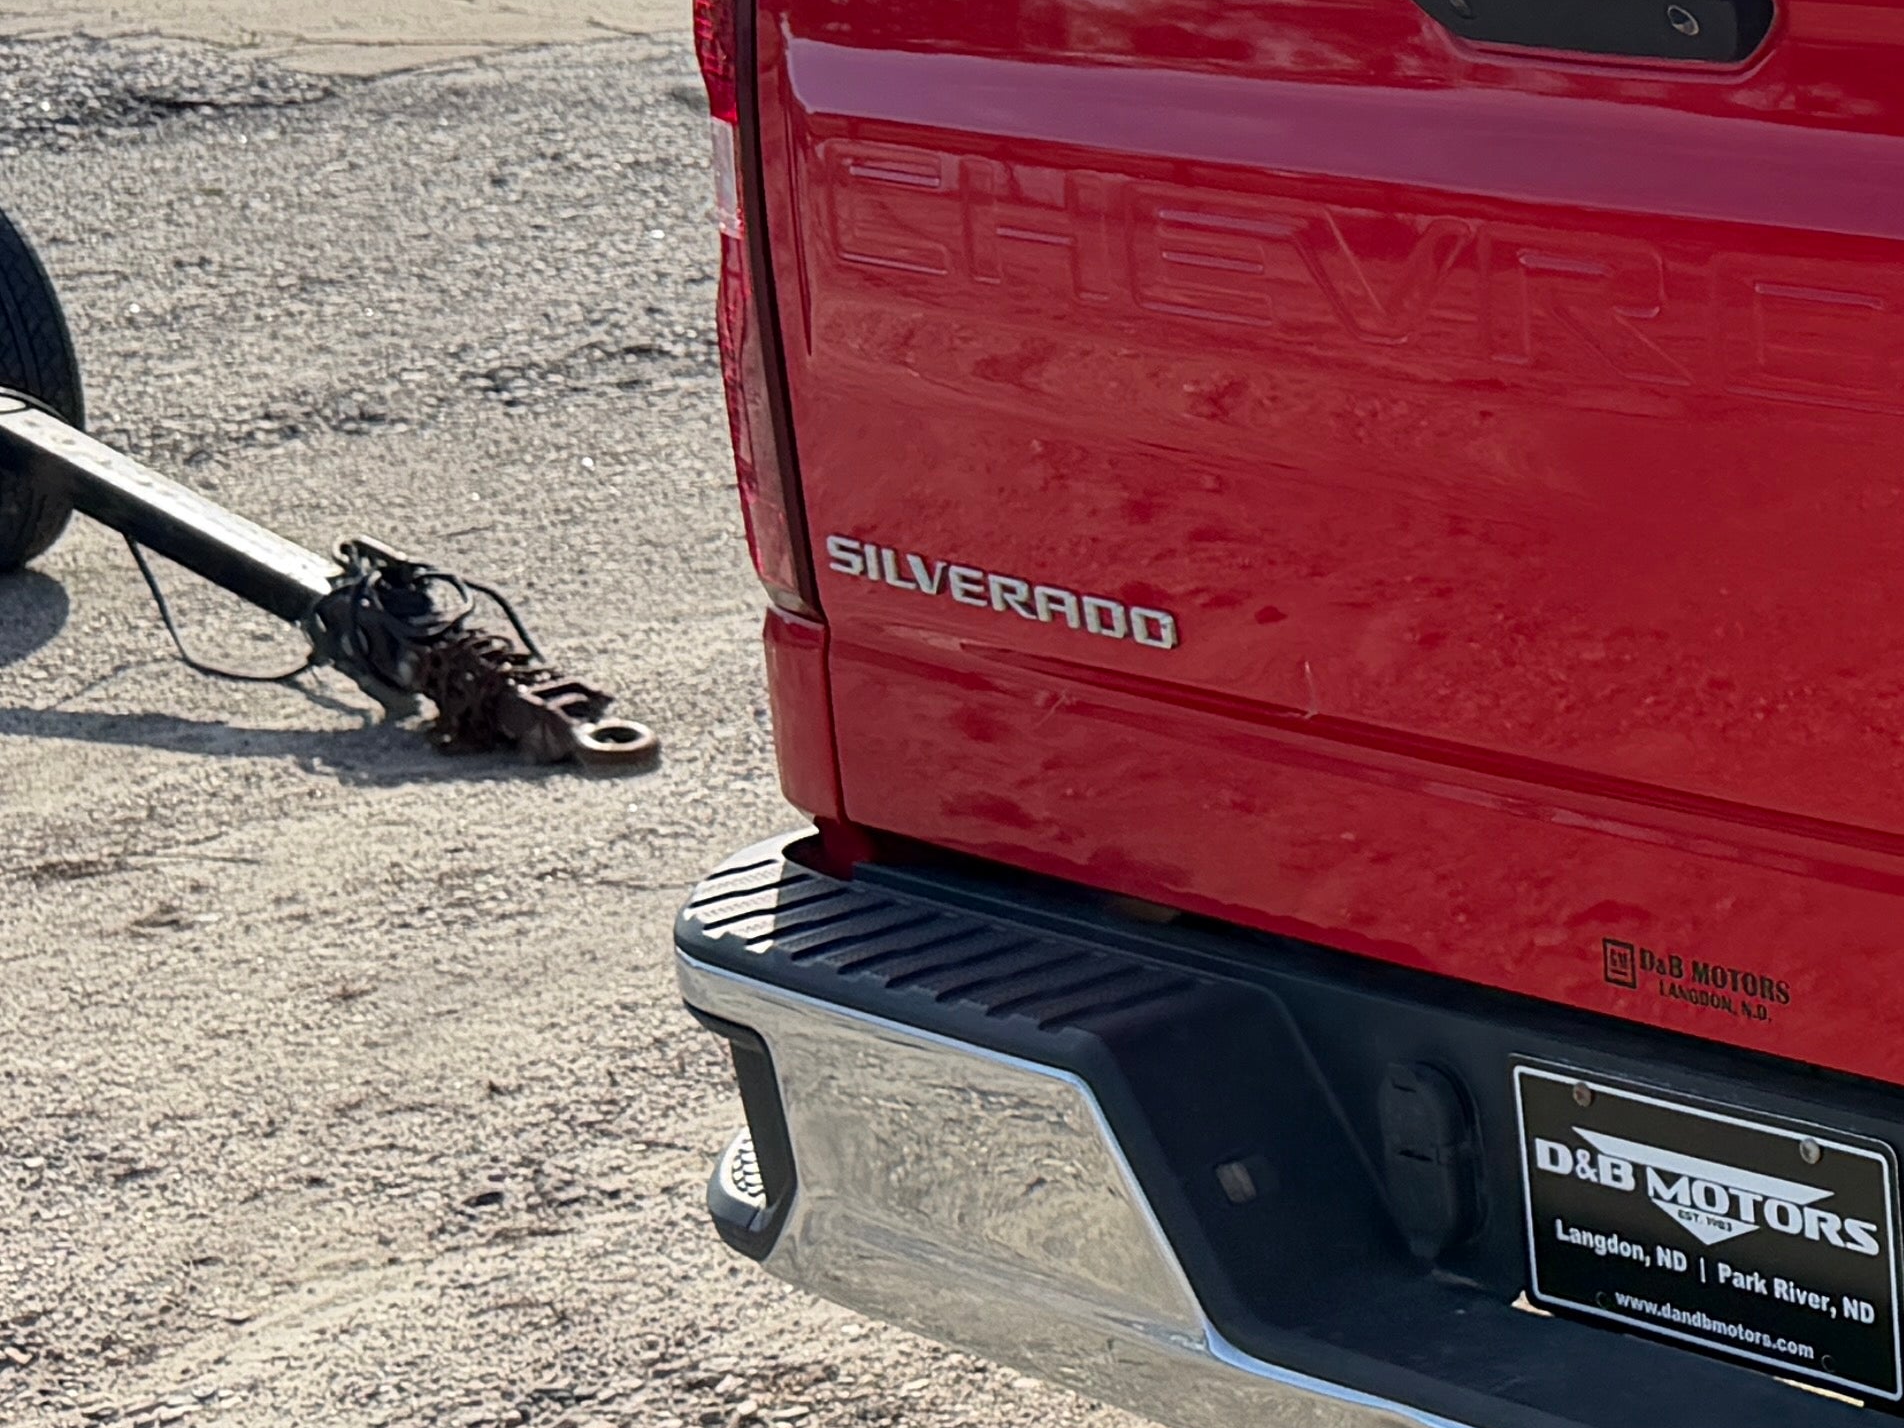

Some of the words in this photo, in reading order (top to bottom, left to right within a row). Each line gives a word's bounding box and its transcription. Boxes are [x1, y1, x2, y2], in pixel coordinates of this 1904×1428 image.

[826, 535, 1179, 649] SILVERADO
[1640, 947, 1683, 979] D&B
[1691, 960, 1790, 1005] MOTORS
[1535, 1138, 1636, 1191] D&B
[1646, 1167, 1879, 1256] MOTORS
[1555, 1219, 1651, 1265] Langdon,
[1656, 1249, 1687, 1272] ND
[1718, 1263, 1768, 1295] Park
[1773, 1278, 1836, 1318] River,
[1843, 1296, 1875, 1324] ND
[1614, 1292, 1814, 1359] www.dandbmotors.com
